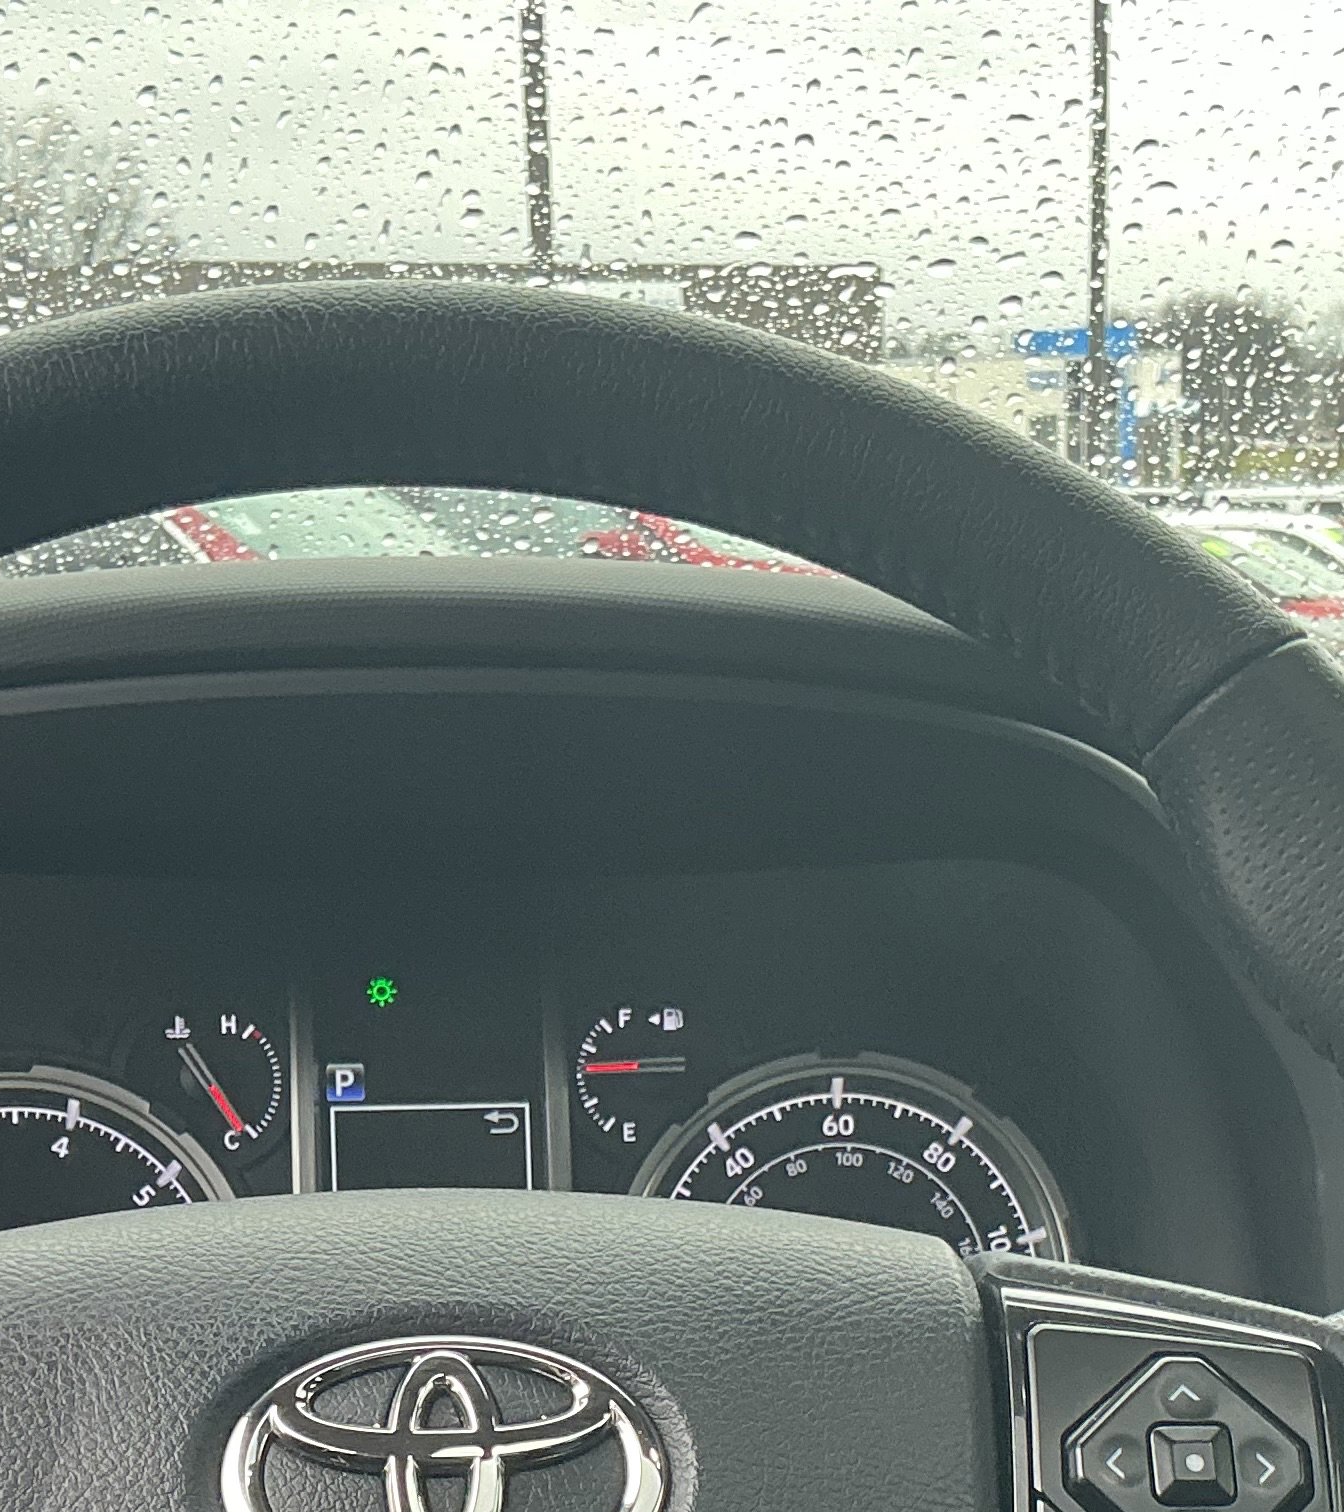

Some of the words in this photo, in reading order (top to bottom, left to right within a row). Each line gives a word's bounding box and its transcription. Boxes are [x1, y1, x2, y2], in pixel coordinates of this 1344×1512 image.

[220, 1015, 237, 1034] H
[618, 1008, 632, 1028] F
[335, 1069, 355, 1097] P
[623, 1123, 636, 1142] E
[821, 1115, 854, 1136] 60
[51, 1137, 69, 1159] 4
[224, 1131, 240, 1151] C
[725, 1147, 755, 1178] 40
[785, 1159, 807, 1177] 80
[835, 1153, 864, 1167] 100
[922, 1142, 955, 1173] 80
[887, 1161, 915, 1184] 120
[132, 1185, 156, 1207] 5
[743, 1186, 764, 1206] 60
[929, 1192, 954, 1218] 140
[958, 1237, 973, 1257] 16
[987, 1225, 1012, 1252] 10
